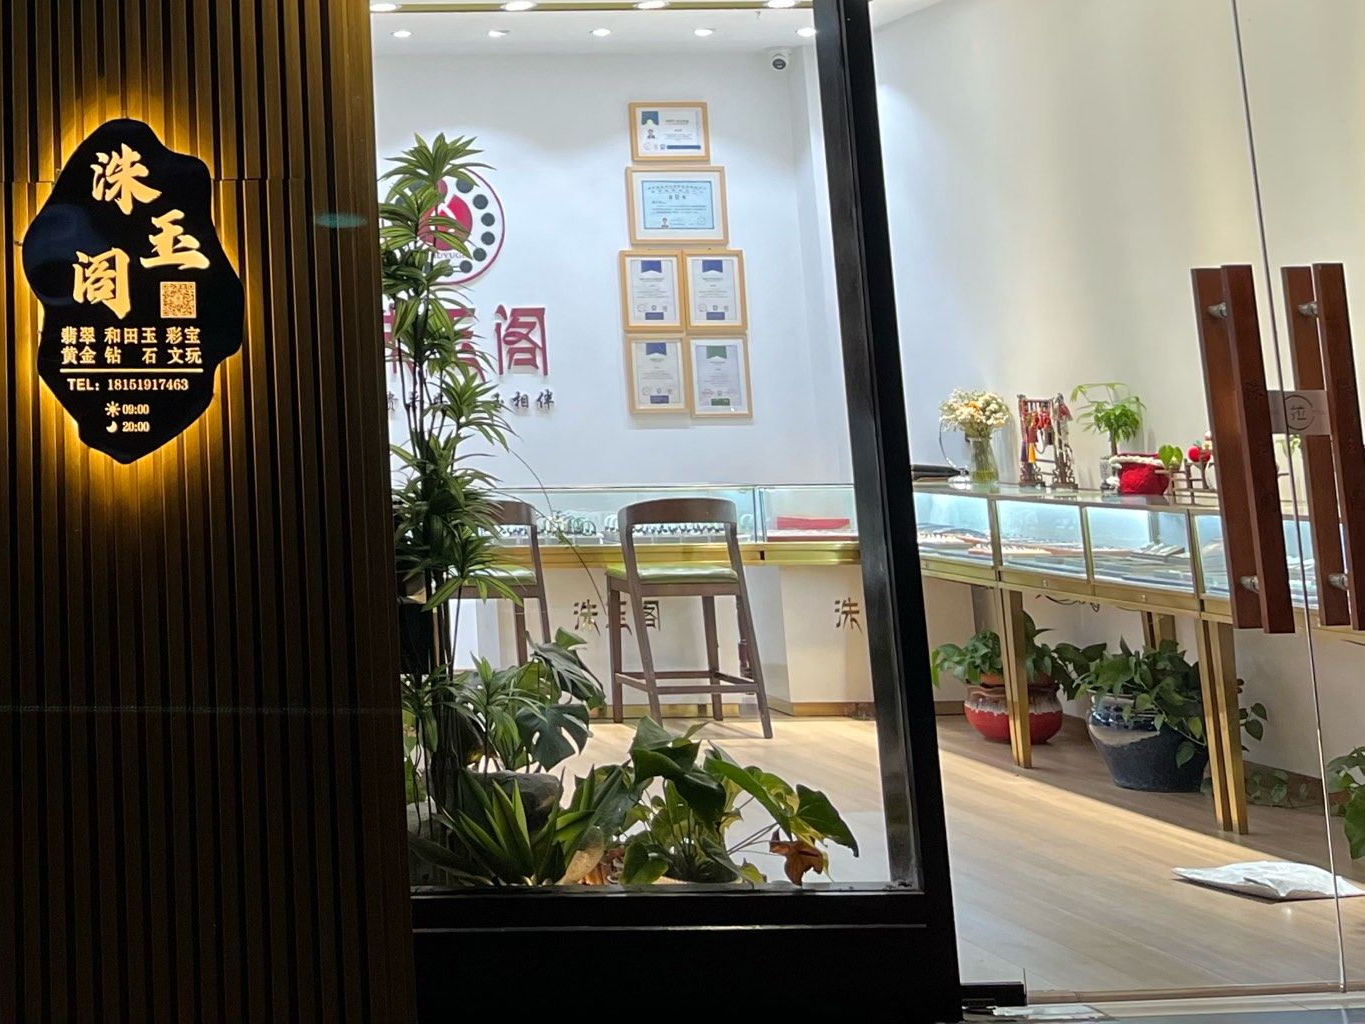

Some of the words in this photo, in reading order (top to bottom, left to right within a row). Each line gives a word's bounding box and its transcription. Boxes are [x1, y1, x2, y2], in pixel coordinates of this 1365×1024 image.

[61, 326, 96, 345] 翡翠
[104, 327, 158, 345] 和田玉
[165, 326, 201, 345] 彩宝
[60, 346, 97, 365] 黄金
[167, 346, 202, 365] 文玩
[107, 378, 189, 391] 18151917463
[122, 403, 150, 415] 09:00
[122, 421, 151, 433] 20:00
